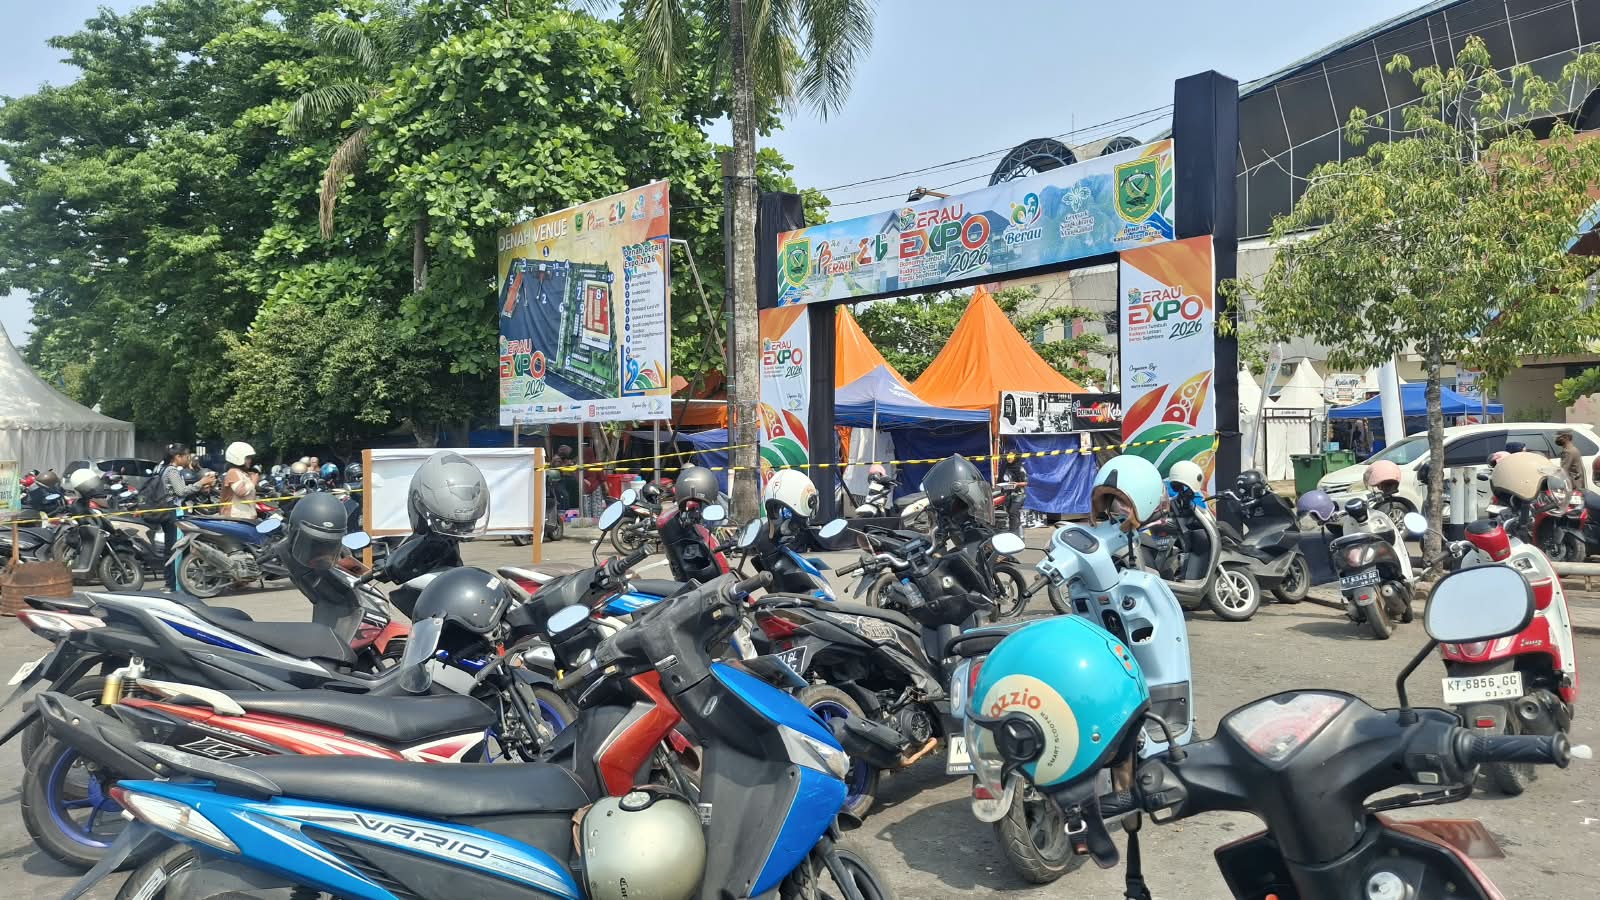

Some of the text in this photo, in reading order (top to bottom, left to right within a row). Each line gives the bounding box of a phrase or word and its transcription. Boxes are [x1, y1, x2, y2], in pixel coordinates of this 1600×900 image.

[499, 231, 531, 251] DENAH
[532, 219, 567, 242] VENUE
[899, 215, 990, 259] EXPO
[1005, 227, 1042, 246] Berau
[624, 243, 664, 257] Denah Berau
[624, 255, 656, 269] Expo 2026
[946, 246, 989, 277] 2026
[509, 274, 515, 284] 5
[542, 295, 547, 304] 2
[597, 289, 602, 300] 8
[560, 304, 565, 313] 6
[1128, 296, 1204, 325] EXPO
[1169, 319, 1203, 340] 2026
[500, 350, 546, 379] EXPO
[566, 357, 571, 366] 6
[764, 348, 802, 365] EXPO
[785, 364, 802, 378] 2026
[525, 375, 545, 400] 2026
[1108, 402, 1122, 420] Keb
[1447, 675, 1517, 691] KT 6856 GG
[1040, 711, 1060, 767] SMART SCOOTER
[354, 814, 490, 859] VARIO
